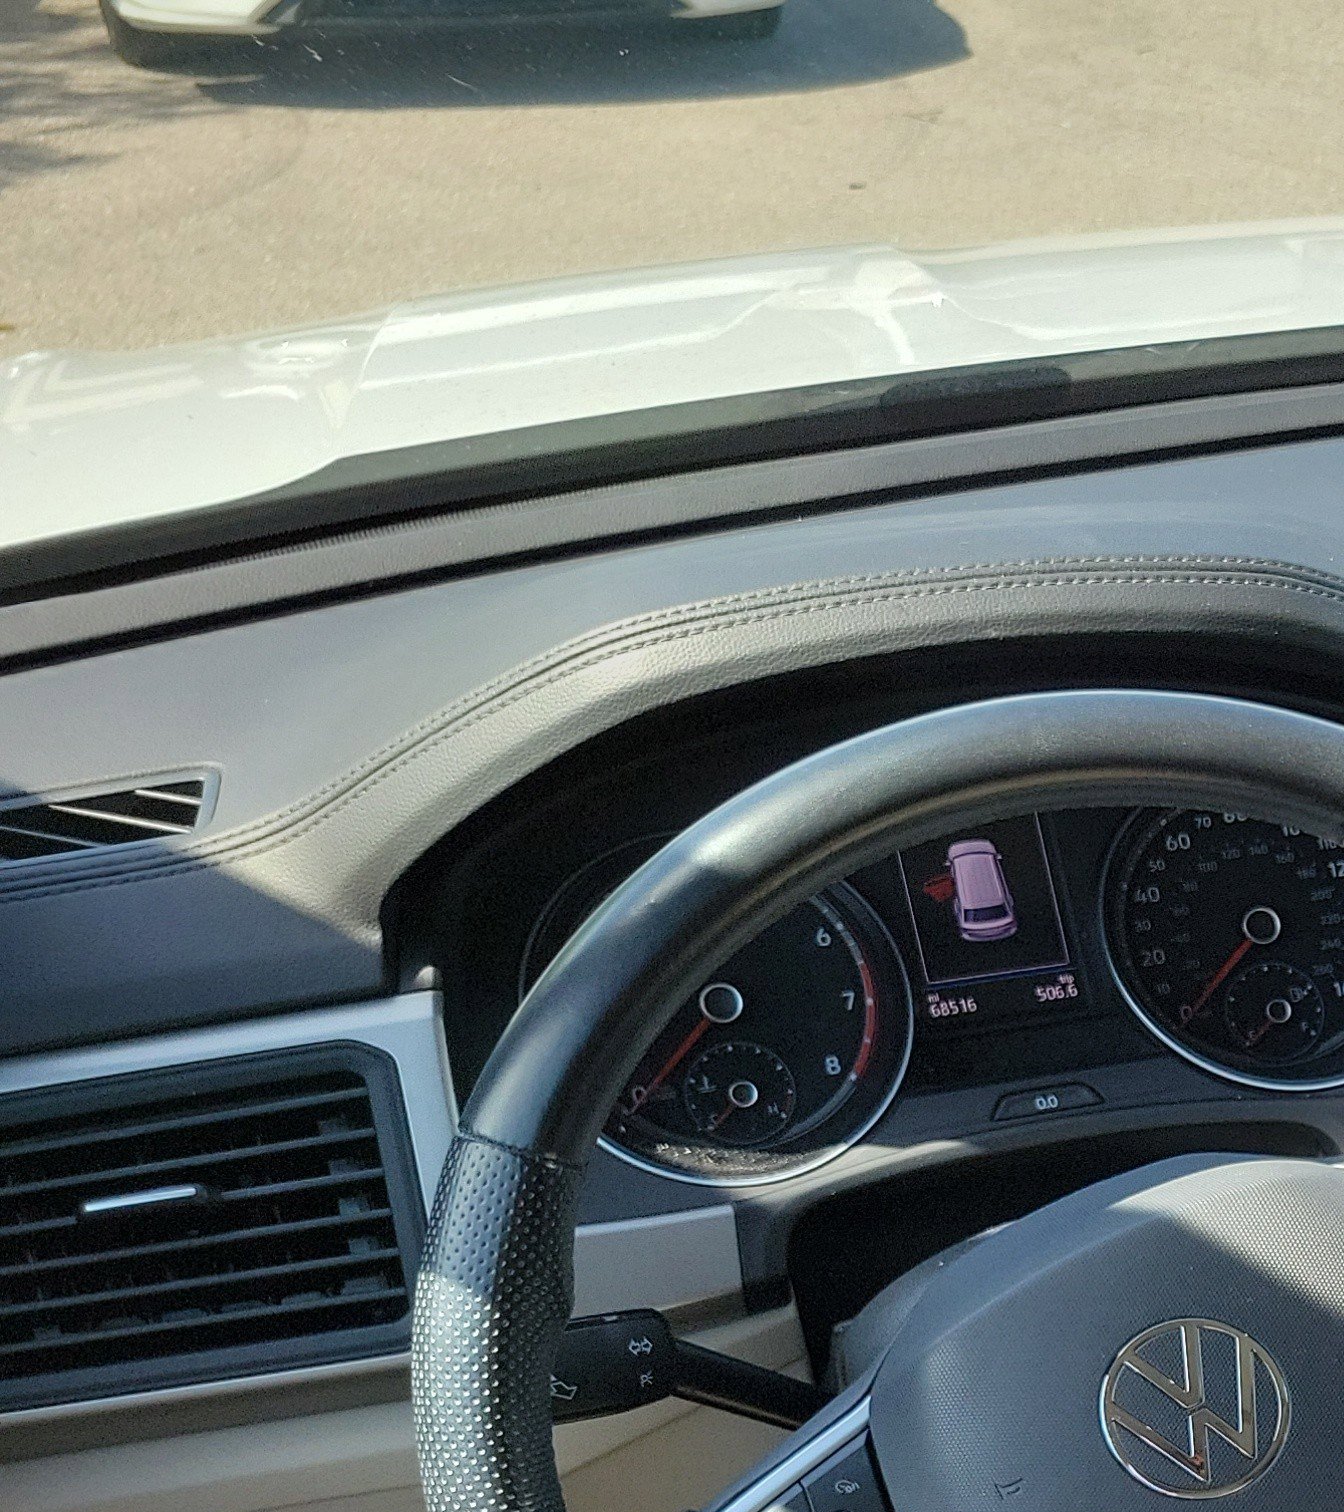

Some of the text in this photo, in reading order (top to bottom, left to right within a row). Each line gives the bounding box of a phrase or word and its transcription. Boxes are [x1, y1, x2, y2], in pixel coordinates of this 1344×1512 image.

[1194, 816, 1212, 829] 70
[1166, 833, 1191, 851] 60
[1135, 887, 1160, 903] 40
[816, 927, 832, 947] 6
[1141, 949, 1166, 967] 20
[840, 989, 856, 1011] 7
[1034, 984, 1079, 1002] 506.6
[929, 998, 978, 1018] 68516
[824, 1054, 842, 1076] 8
[1034, 1094, 1059, 1111] 0.0
